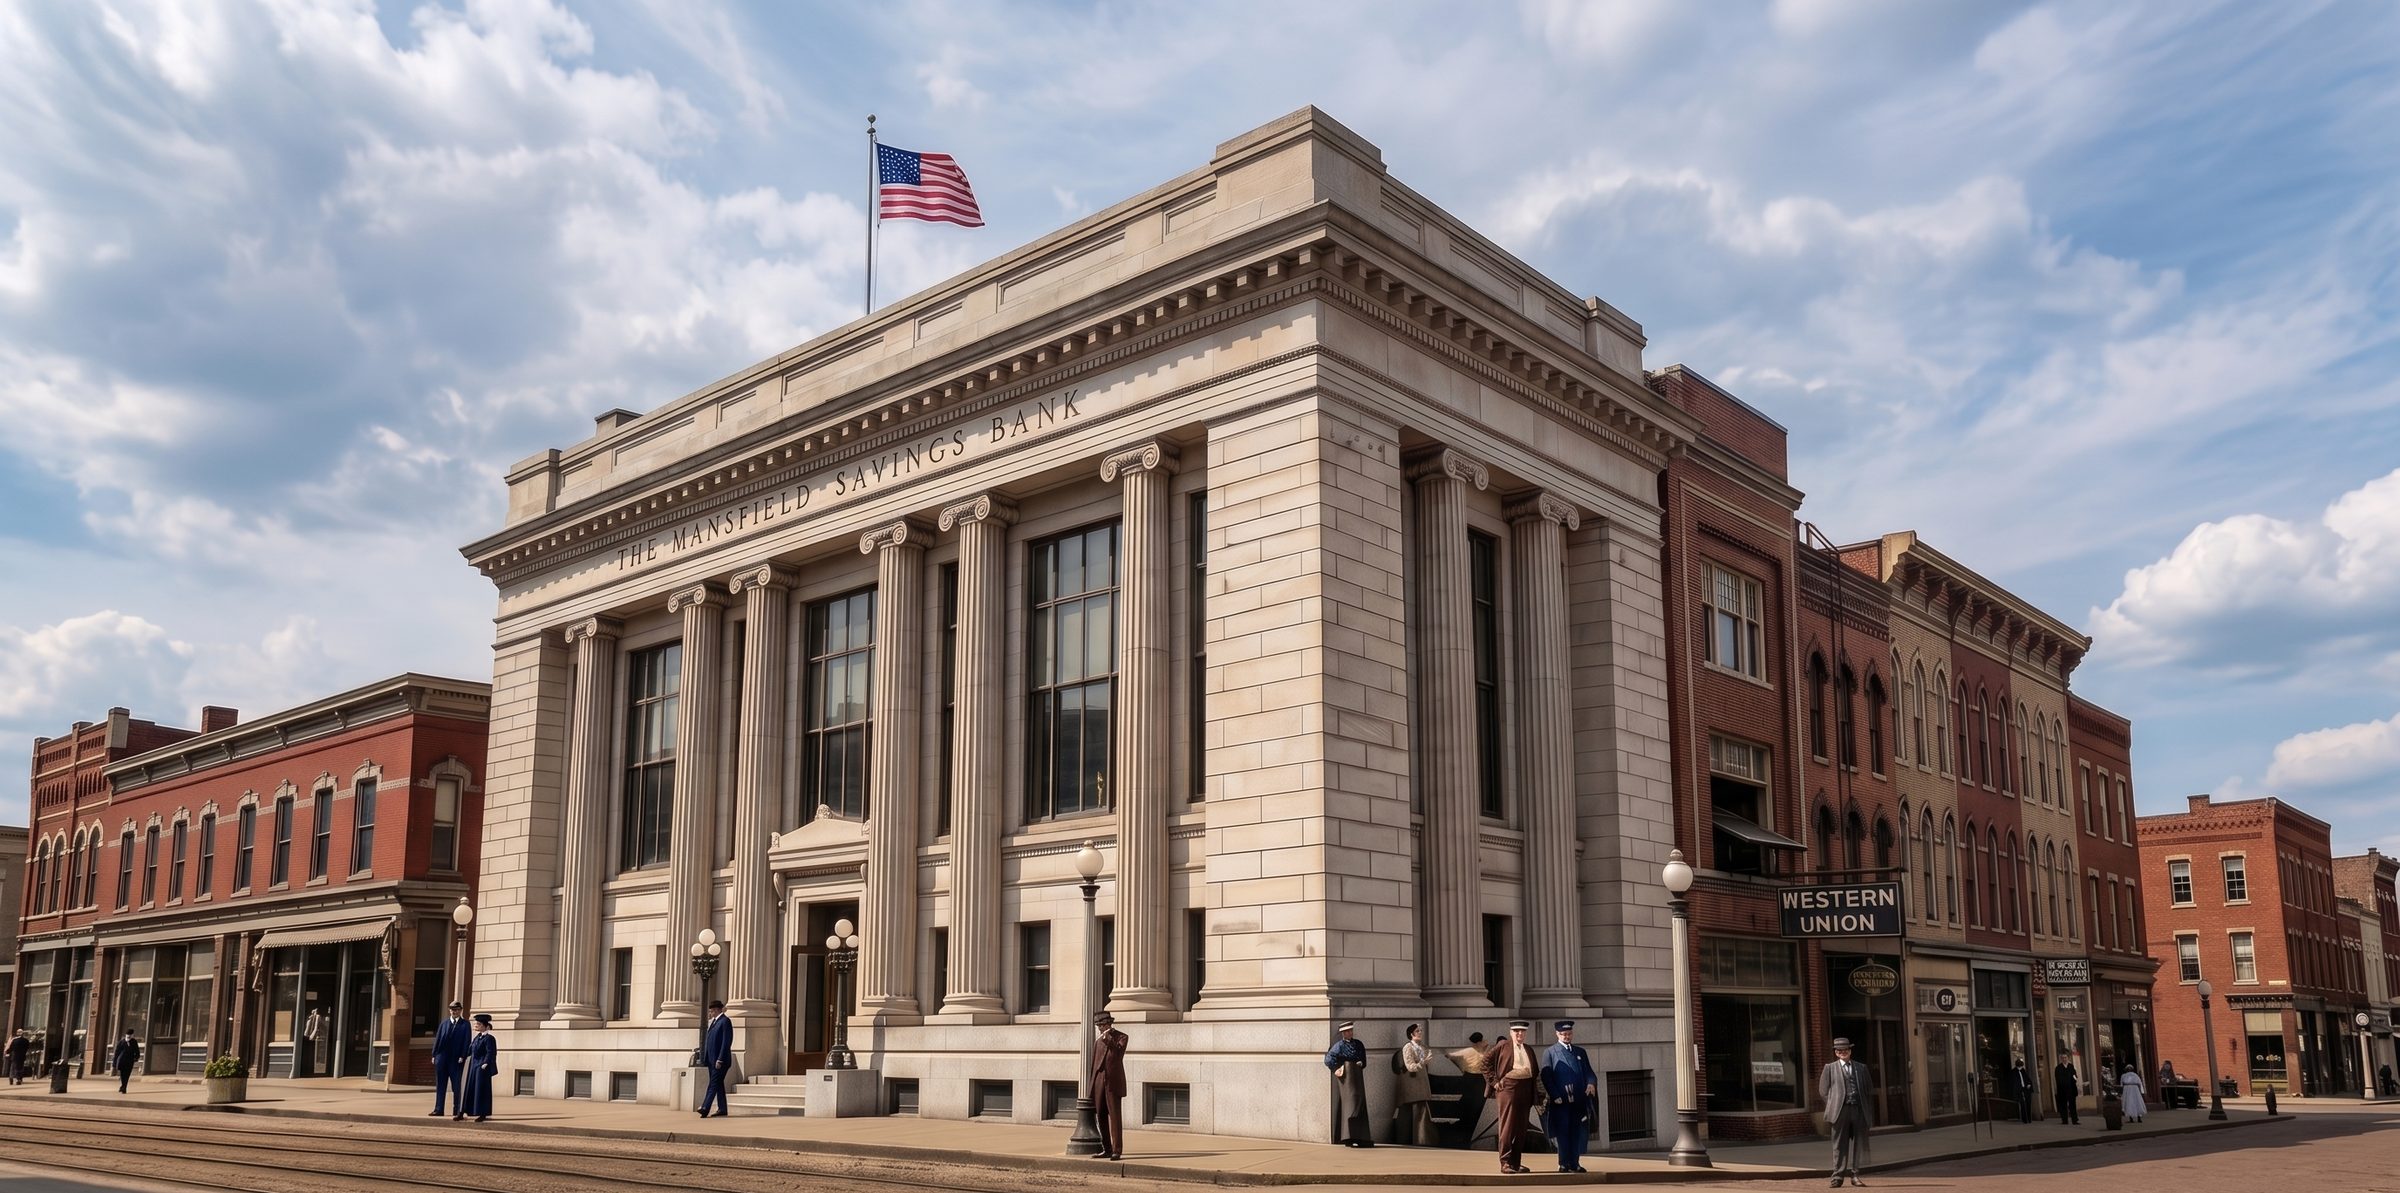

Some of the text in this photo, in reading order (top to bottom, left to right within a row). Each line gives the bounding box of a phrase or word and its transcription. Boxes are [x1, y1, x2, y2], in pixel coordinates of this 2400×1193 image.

[618, 389, 1081, 571] THE MANSFIELD SAVINGS BANK
[1782, 888, 1895, 909] WESTERN
[1800, 914, 1875, 933] UNION
